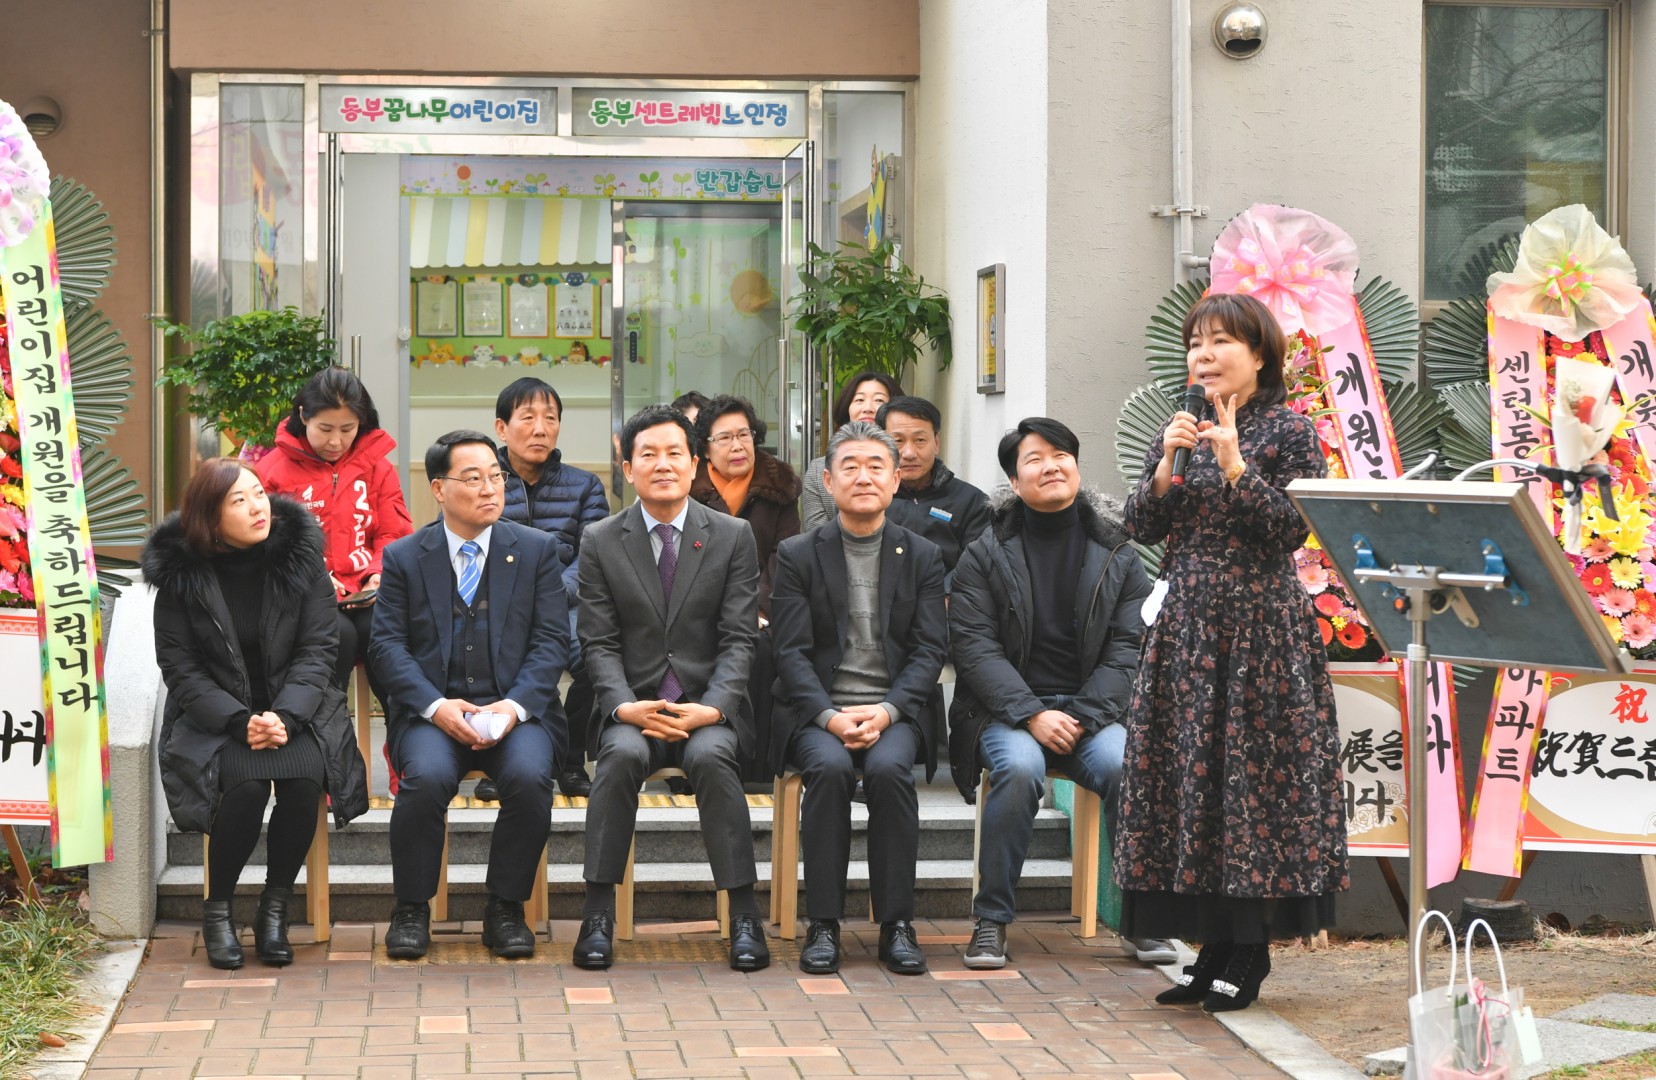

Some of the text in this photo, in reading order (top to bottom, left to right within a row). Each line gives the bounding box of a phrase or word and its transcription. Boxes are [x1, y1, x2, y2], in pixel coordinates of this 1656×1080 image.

[12, 265, 56, 394] 어린이집
[30, 406, 75, 503] 개원을
[1335, 352, 1388, 479] 개원
[1485, 670, 1543, 783] 아파트
[1610, 682, 1649, 724] 祝
